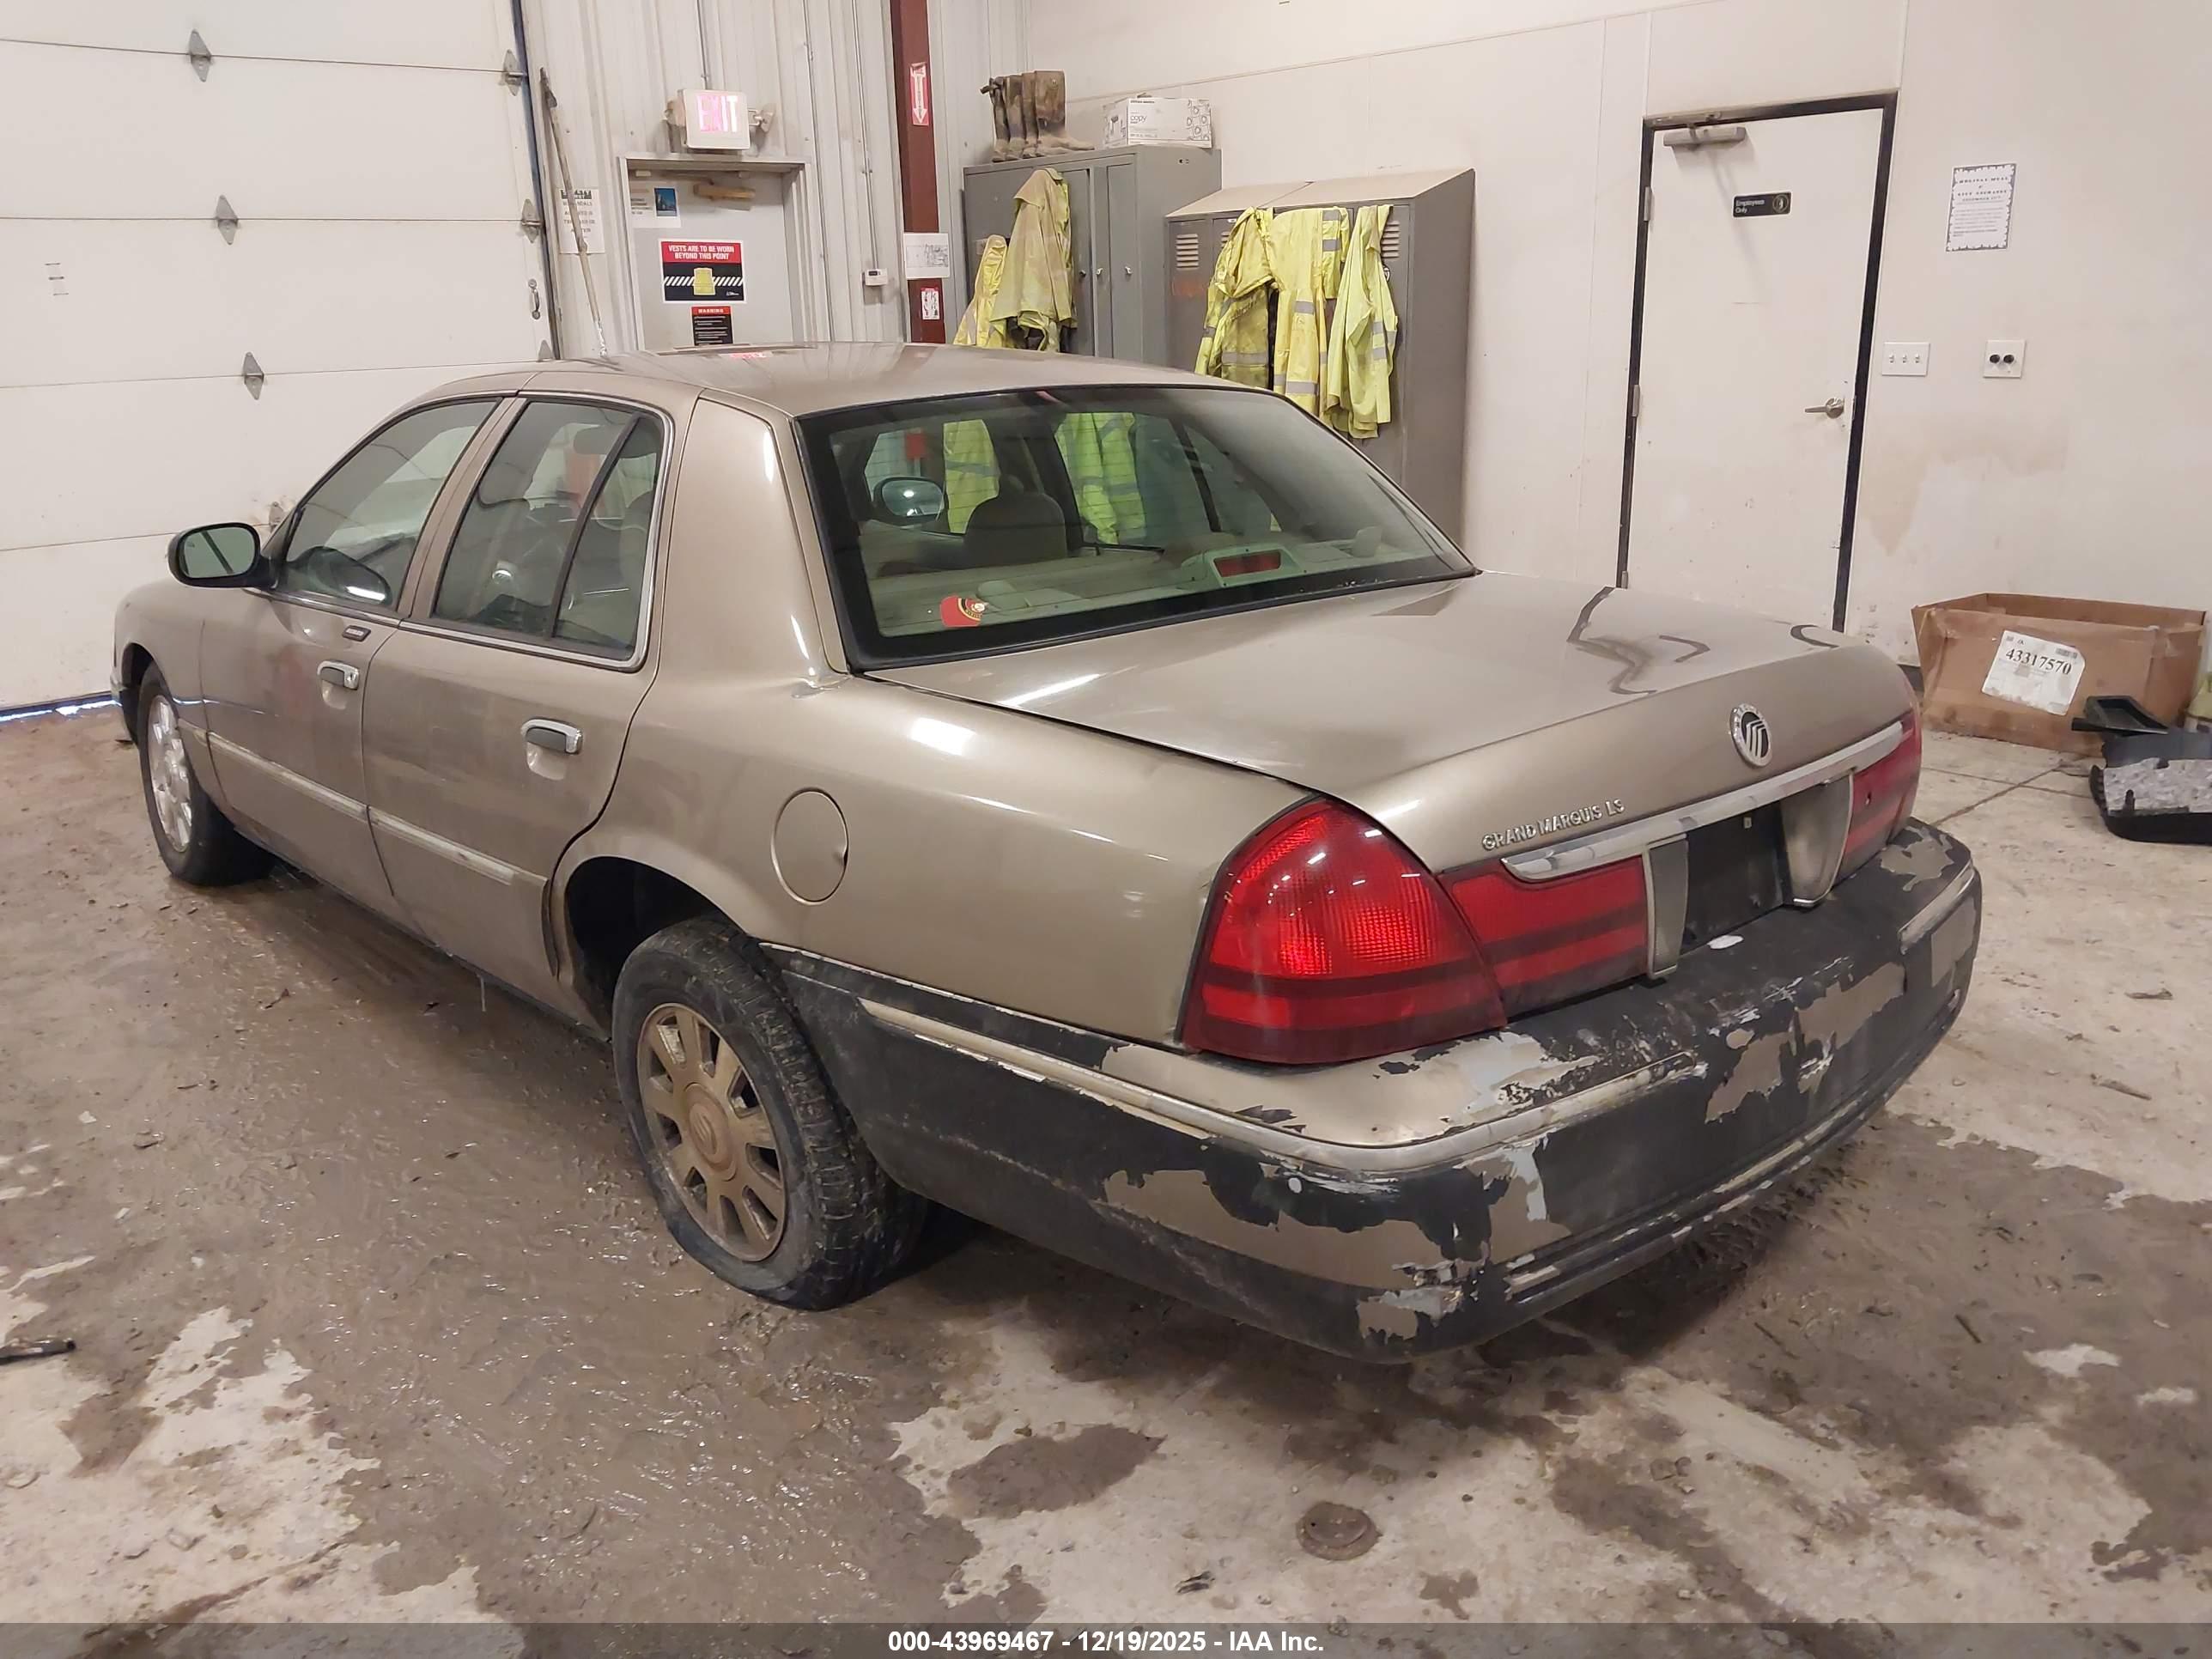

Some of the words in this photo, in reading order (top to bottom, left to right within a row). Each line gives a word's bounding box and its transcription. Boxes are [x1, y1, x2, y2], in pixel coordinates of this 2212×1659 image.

[696, 94, 738, 132] EXIT
[2005, 648, 2072, 675] 43317570
[1482, 824, 1536, 850] GRAND
[1537, 805, 1602, 835] MARQUIS
[1605, 799, 1625, 816] LS
